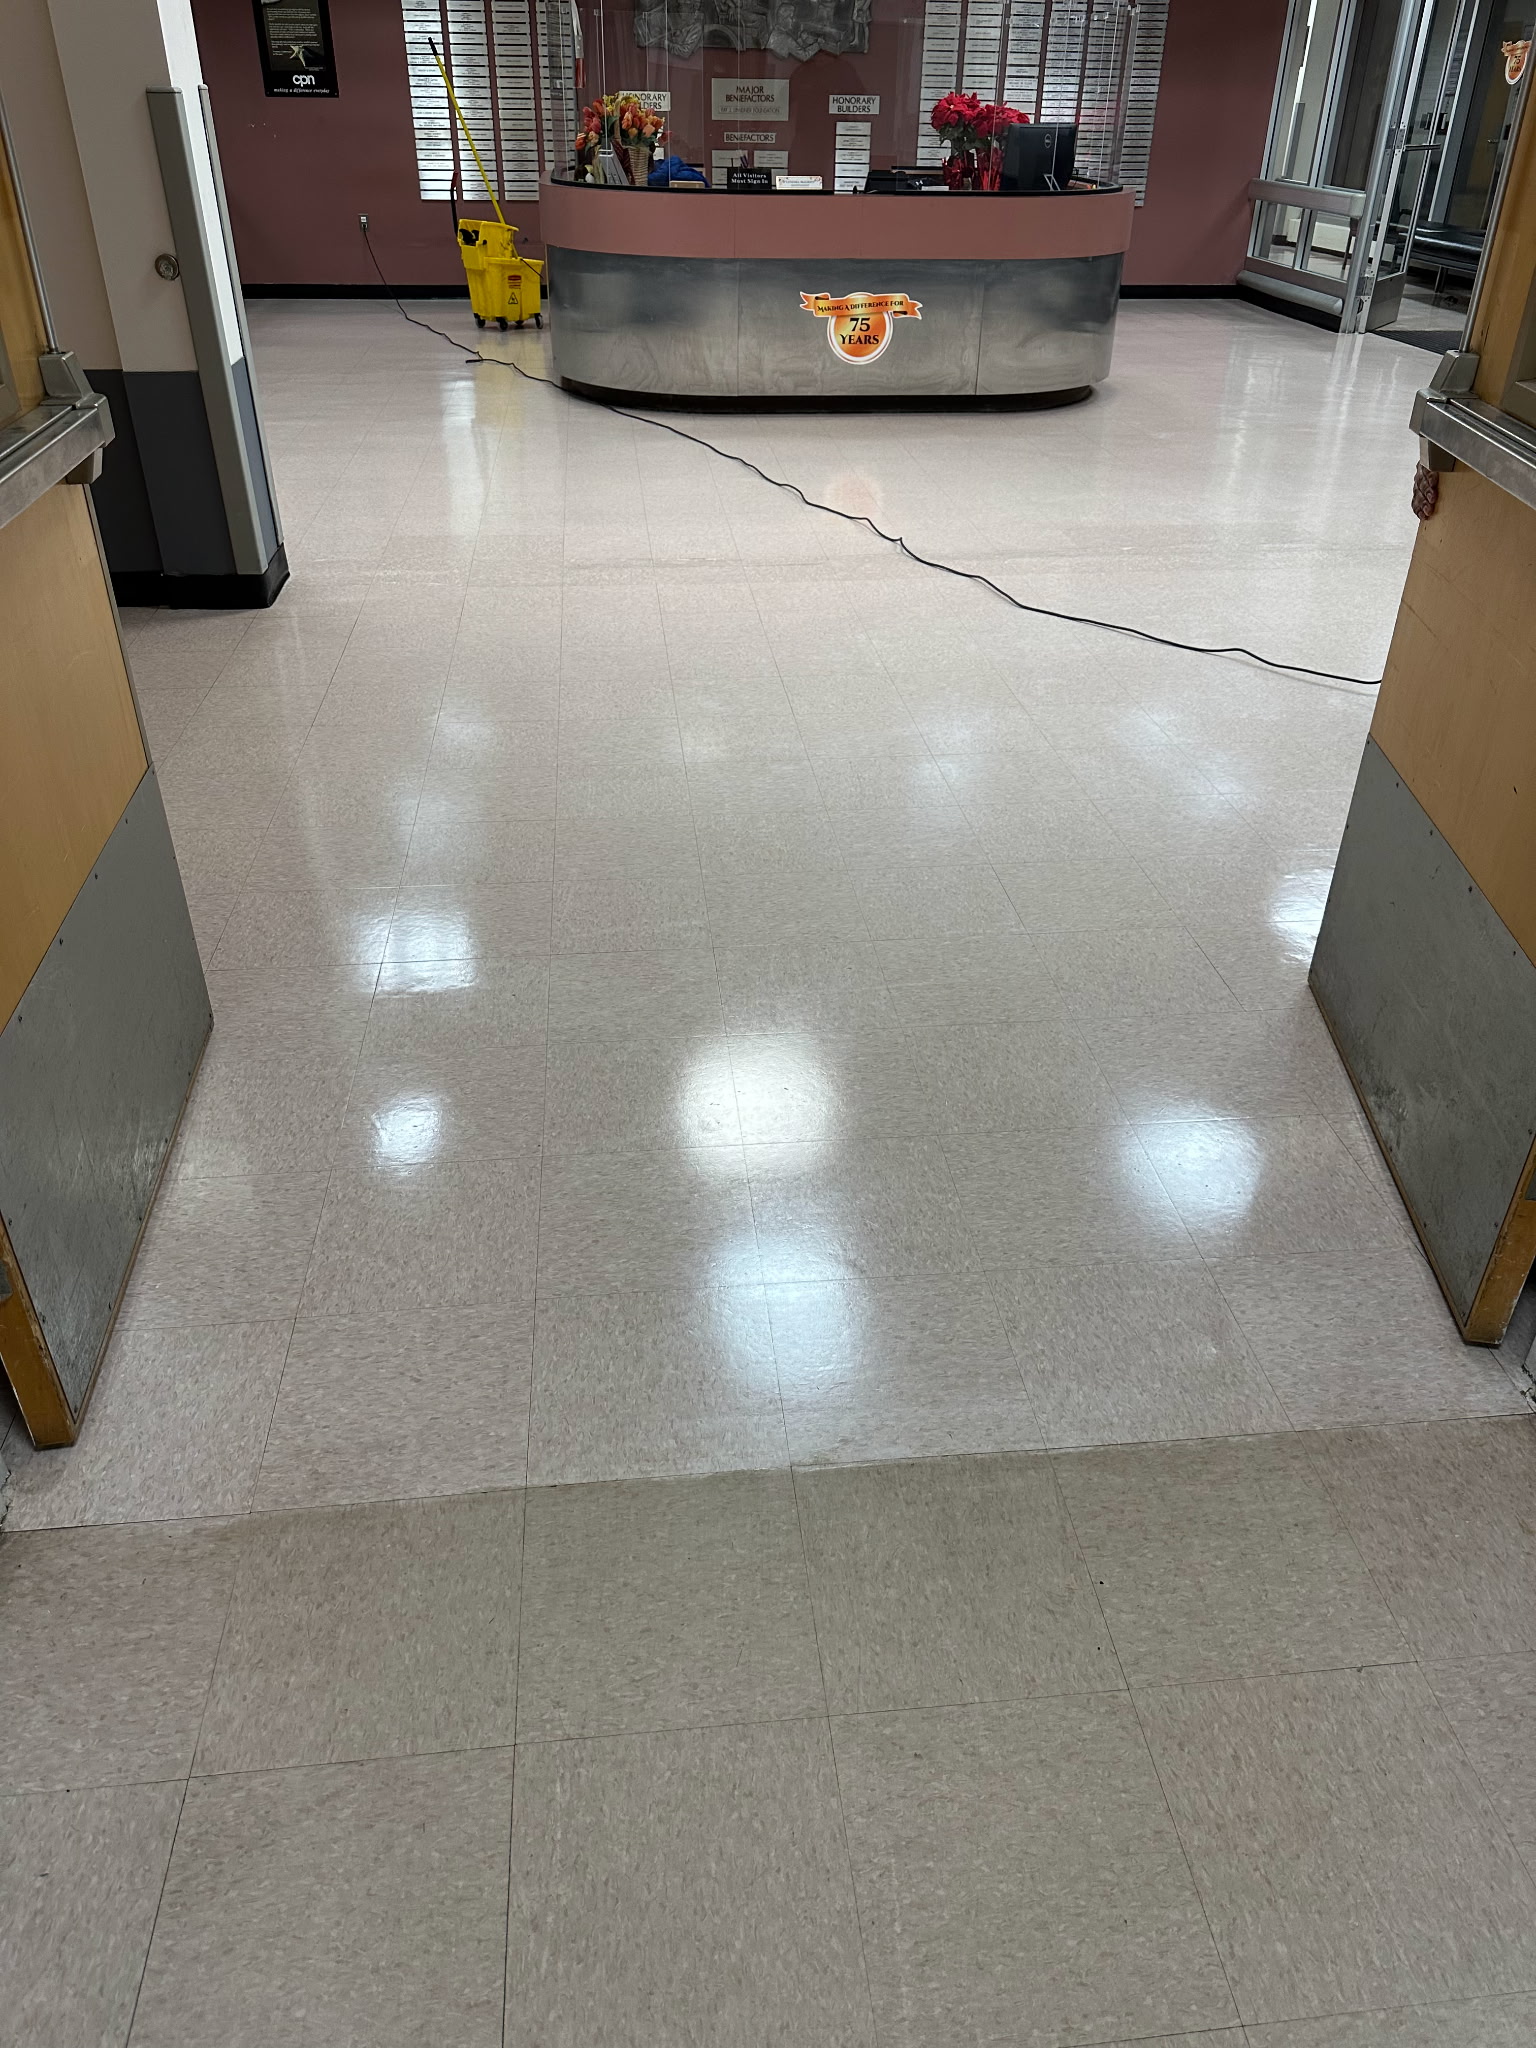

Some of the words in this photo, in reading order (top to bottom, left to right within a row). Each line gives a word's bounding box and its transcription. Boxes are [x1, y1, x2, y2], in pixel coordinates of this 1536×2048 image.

[292, 75, 316, 87] cpn
[735, 86, 765, 95] MAJOR
[725, 95, 775, 103] BENEFACTORS
[837, 105, 871, 113] BUILDERS
[725, 133, 774, 142] BENEFACTORS
[850, 301, 889, 310] DIFFERENCE
[849, 317, 871, 332] 75
[840, 334, 879, 345] YEARS
